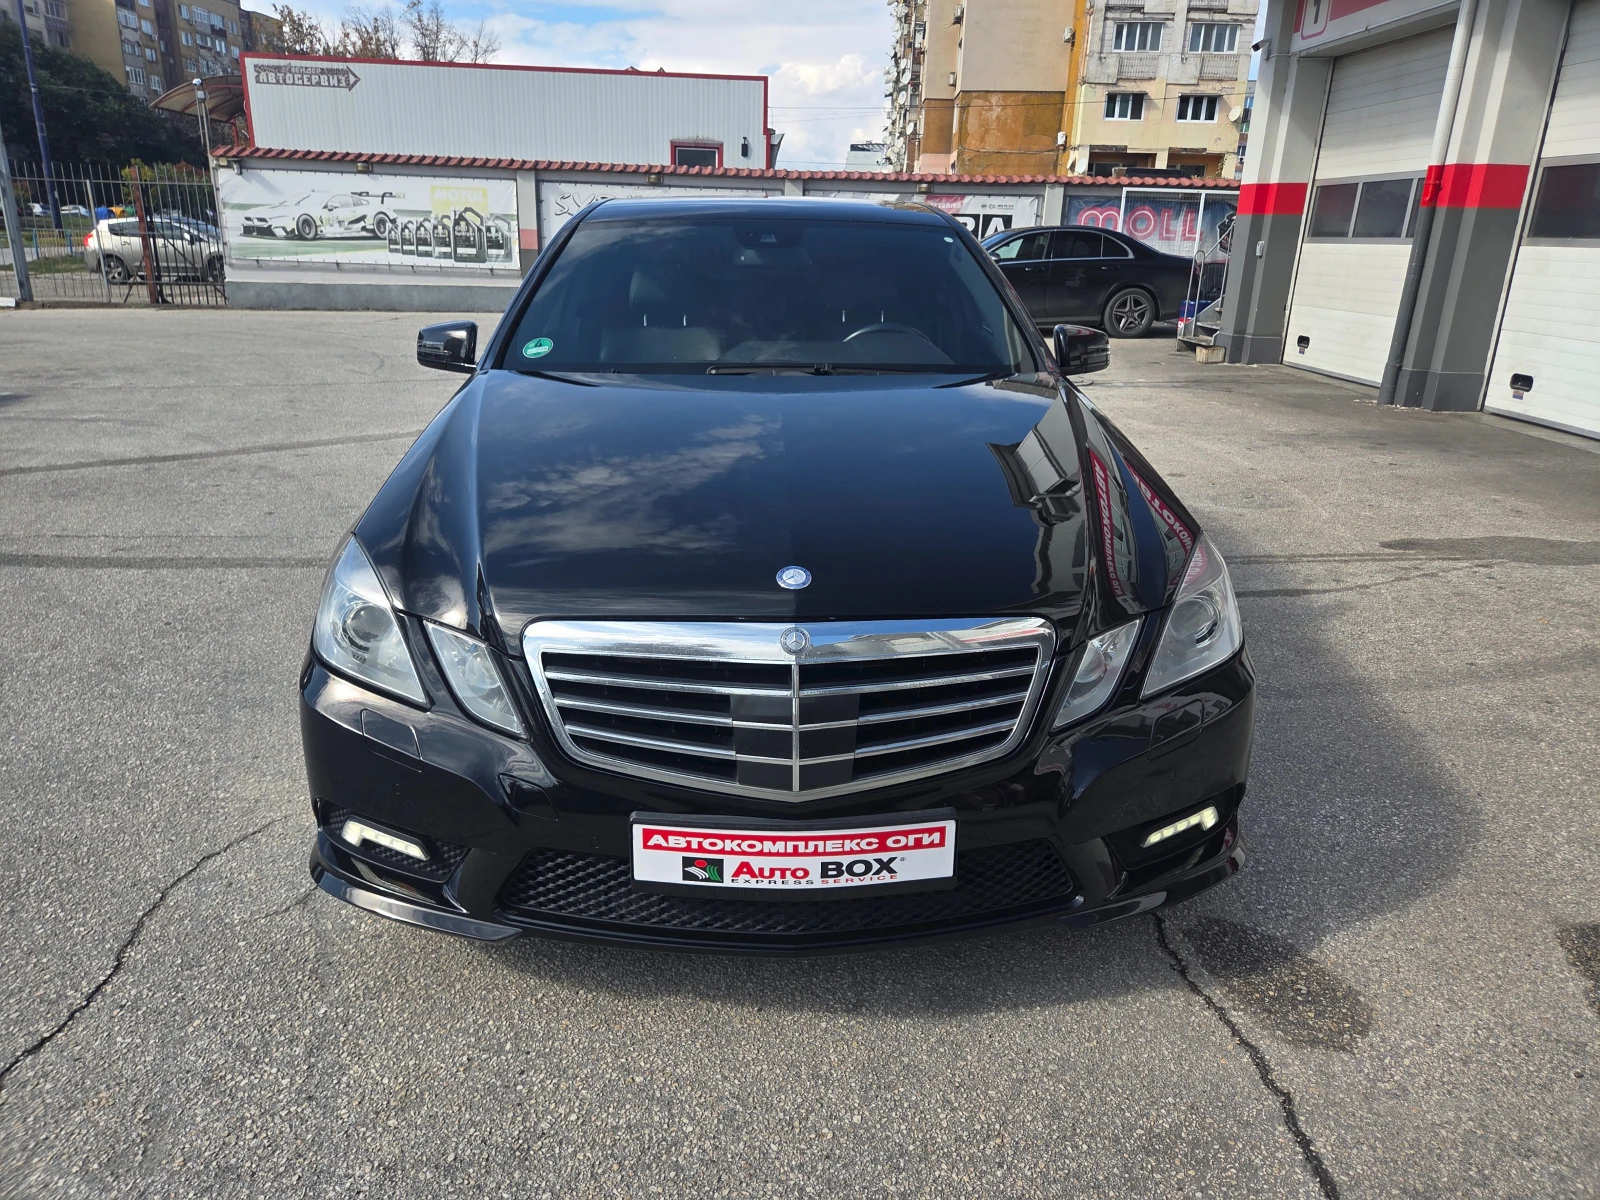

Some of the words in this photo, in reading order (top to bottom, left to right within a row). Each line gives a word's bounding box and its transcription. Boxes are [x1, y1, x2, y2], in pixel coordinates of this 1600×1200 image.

[259, 71, 347, 87] АВТОСЕРВИЗ
[433, 187, 486, 202] MOTUL
[646, 835, 880, 853] АВТОКОМПЛЕКС
[886, 832, 941, 847] ОГИ
[820, 856, 898, 879] BOX
[731, 878, 814, 886] EXPRESS
[821, 874, 898, 885] SERVICE
